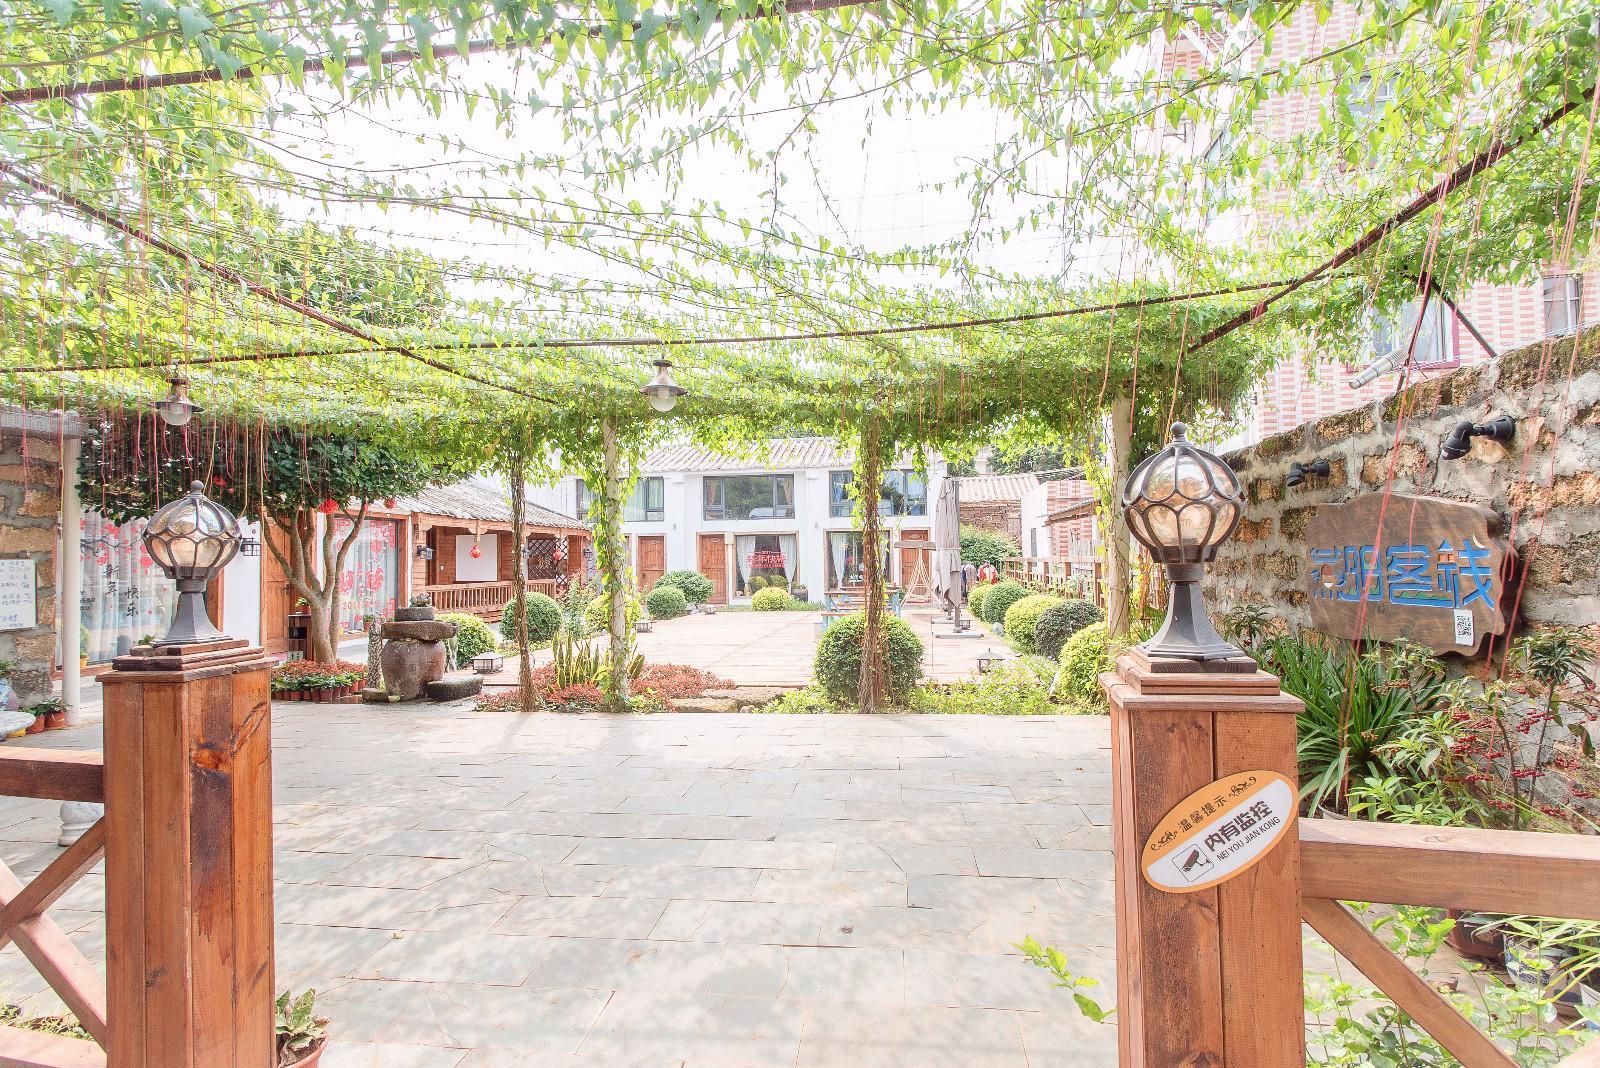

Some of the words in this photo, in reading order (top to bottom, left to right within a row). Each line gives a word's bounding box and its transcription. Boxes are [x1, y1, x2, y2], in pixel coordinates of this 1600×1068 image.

[103, 564, 121, 597] 新年
[124, 585, 140, 617] 快乐
[1178, 795, 1228, 832] 温馨提示
[1204, 800, 1272, 852] 内有监控
[1216, 849, 1230, 861] NEI
[1228, 839, 1245, 853] YOU
[1245, 829, 1261, 843] JIAN
[1260, 816, 1280, 833] KONG
